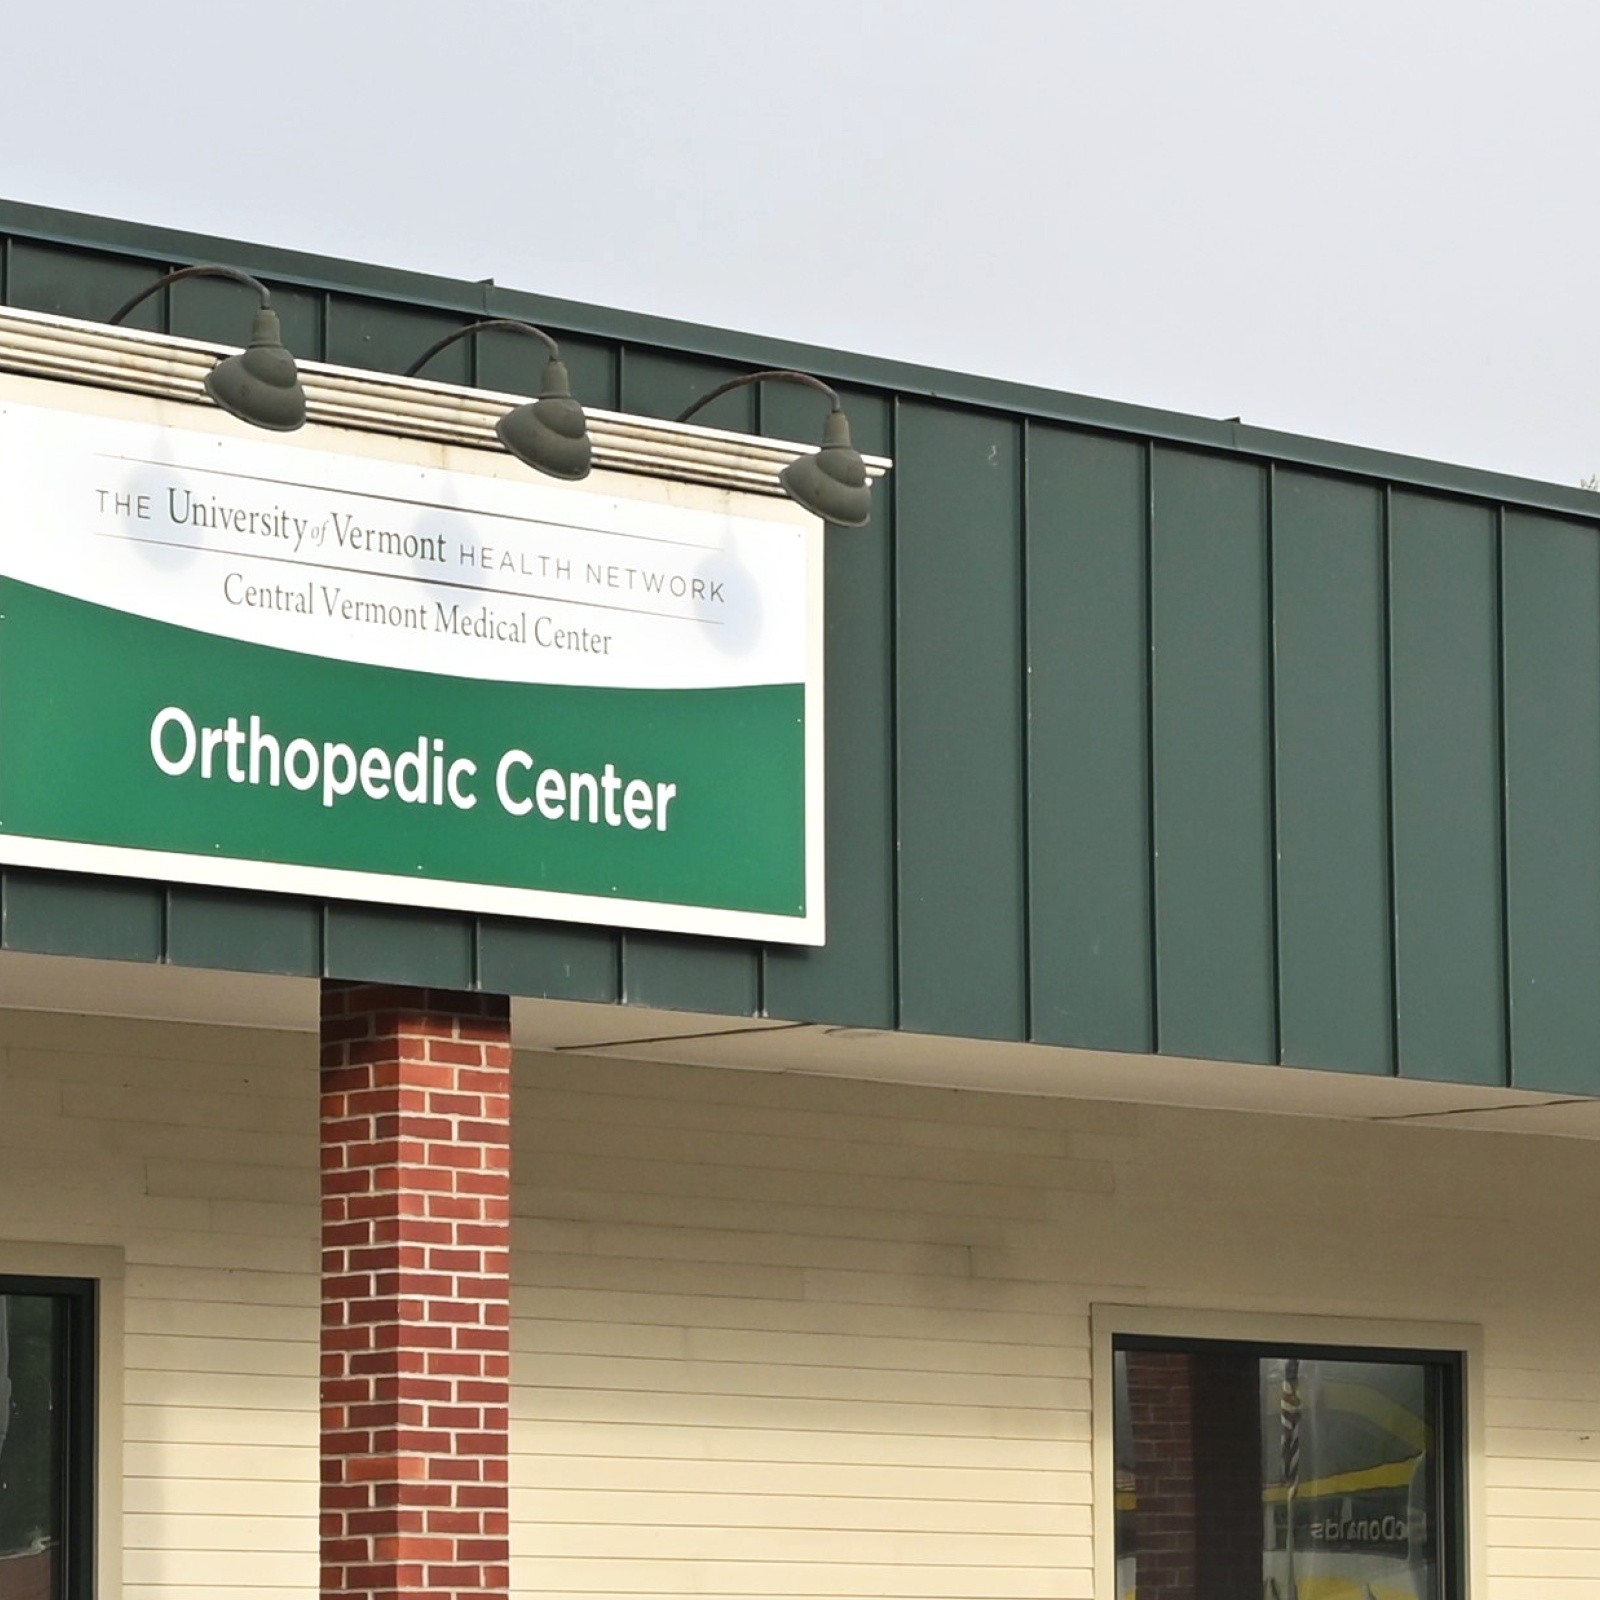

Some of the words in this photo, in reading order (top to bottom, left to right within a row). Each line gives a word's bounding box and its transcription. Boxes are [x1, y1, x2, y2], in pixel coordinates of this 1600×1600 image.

[95, 489, 152, 520] THE
[167, 486, 309, 553] University
[311, 520, 330, 547] of
[330, 511, 447, 563] Vermont
[459, 543, 571, 581] HEALTH
[586, 563, 726, 603] NETWORK
[223, 572, 314, 615] Central
[321, 585, 428, 631] Vermont
[434, 601, 526, 644] Medical
[534, 615, 612, 655] Center
[150, 705, 477, 809] Orthopedic
[496, 748, 676, 832] Center
